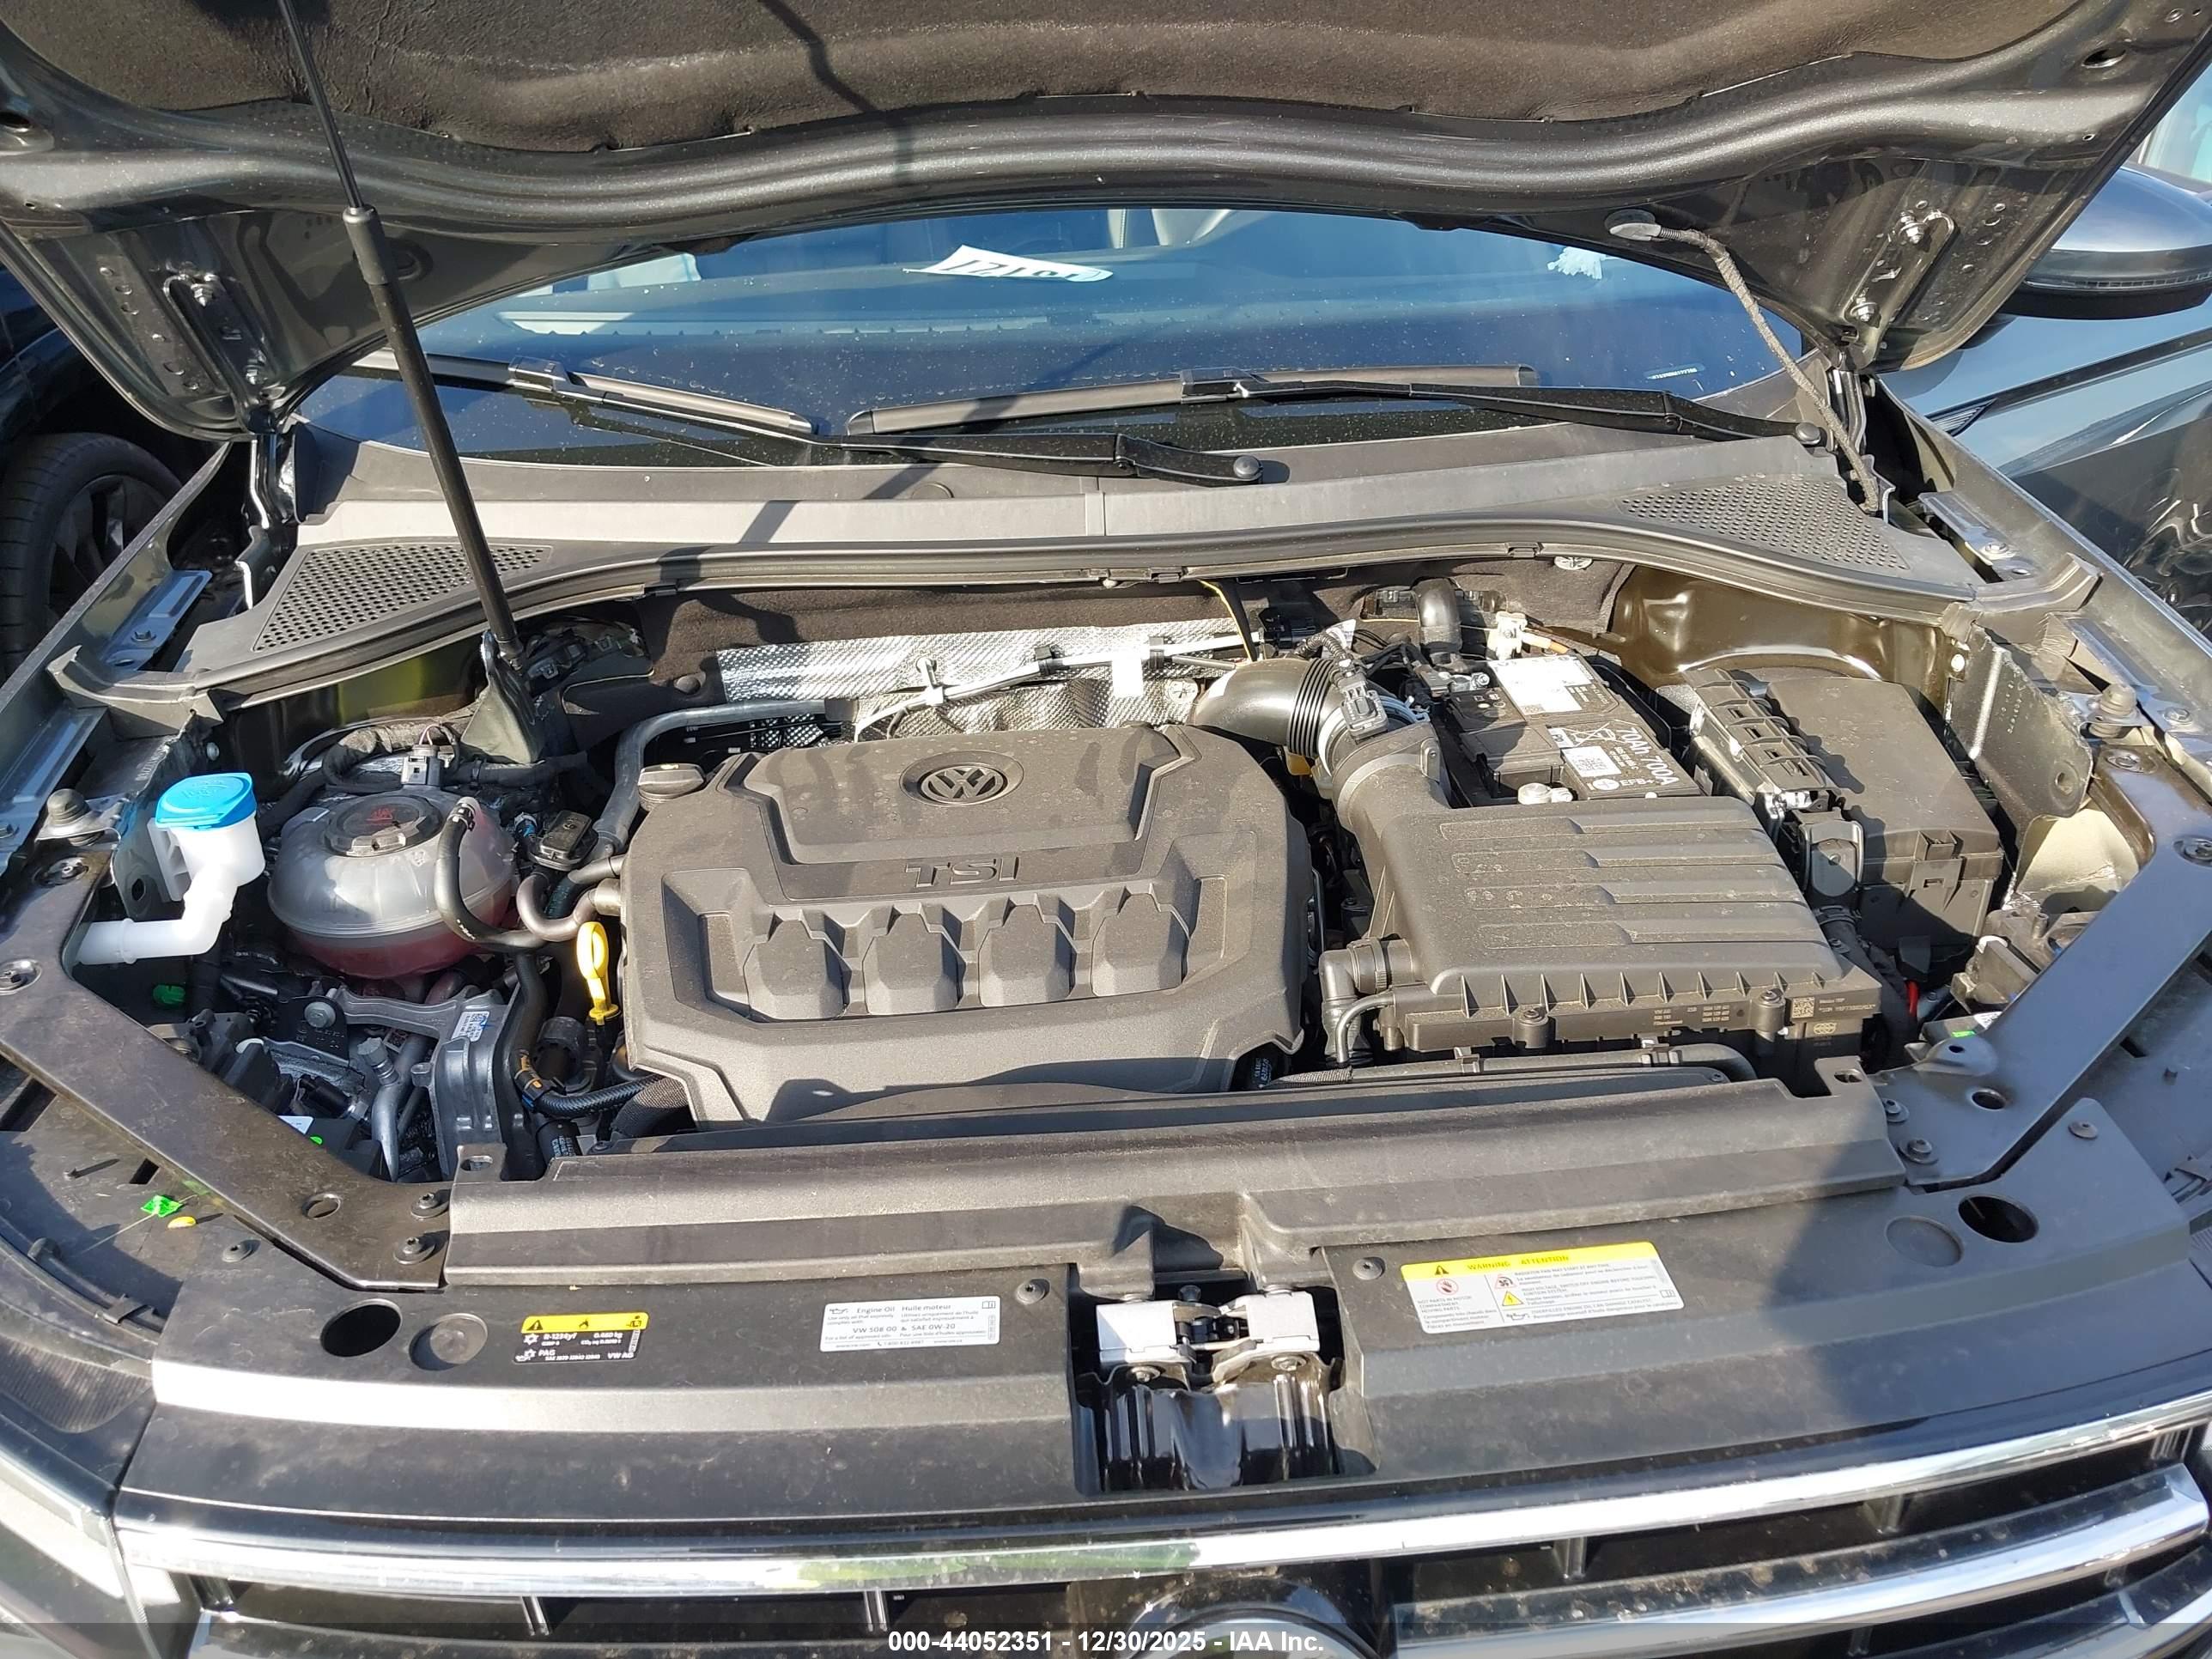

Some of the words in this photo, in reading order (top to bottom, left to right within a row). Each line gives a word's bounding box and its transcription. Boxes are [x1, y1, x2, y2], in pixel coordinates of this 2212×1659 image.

[1616, 727, 1653, 755] 70Ah
[1641, 755, 1680, 786] 700A
[905, 856, 1019, 888] TSI
[1467, 1261, 1511, 1270] WARNING
[1520, 1255, 1570, 1265] ATTENTION
[543, 1333, 577, 1342] R-1234yf
